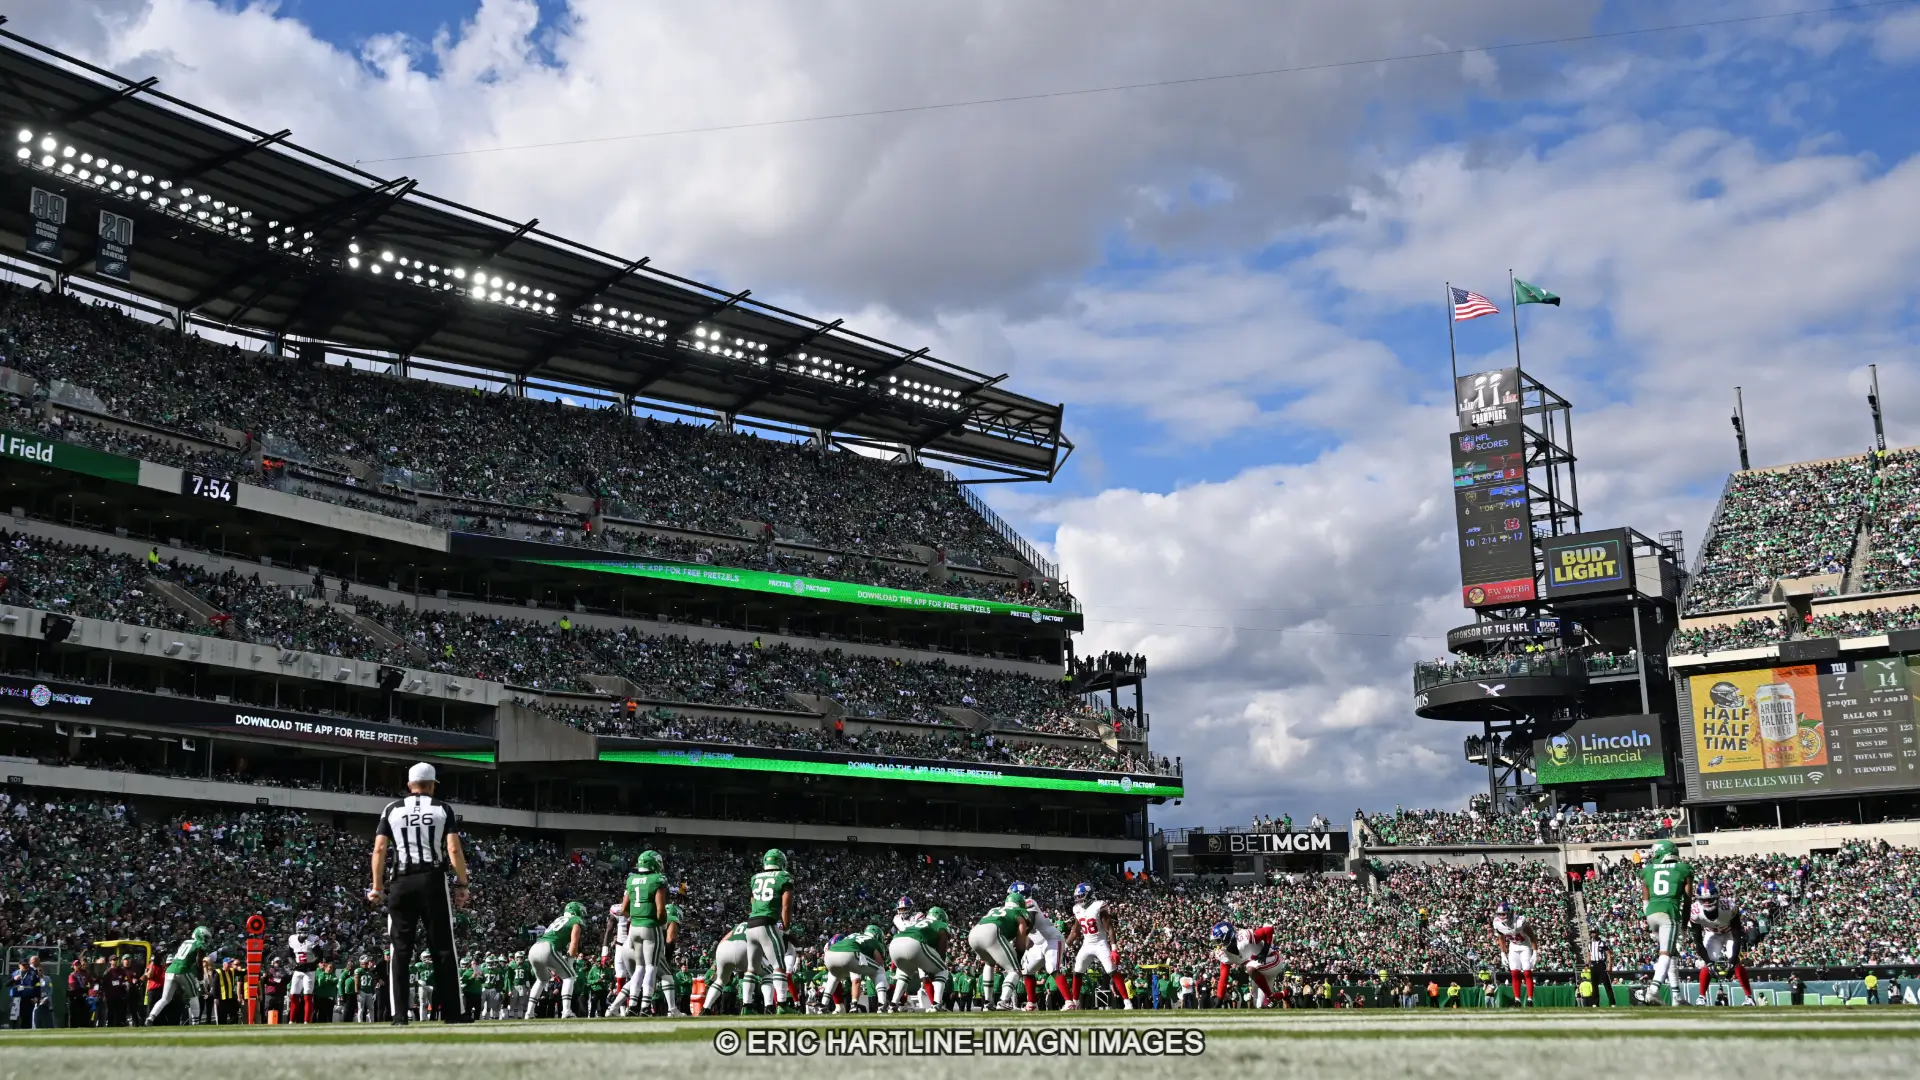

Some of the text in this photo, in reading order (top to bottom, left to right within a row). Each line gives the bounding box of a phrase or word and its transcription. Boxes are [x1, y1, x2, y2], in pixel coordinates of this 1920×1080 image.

[33, 189, 64, 224] 99
[35, 221, 59, 233] JEROME
[36, 228, 57, 240] BROWN
[101, 212, 132, 245] 20
[102, 249, 127, 261] DAWKINS
[107, 244, 123, 253] BRIAN
[1472, 409, 1507, 424] CHAMPIONS
[9, 437, 53, 462] Field
[1476, 440, 1508, 450] SCORES
[1510, 468, 1515, 476] 3
[192, 475, 231, 501] 7:54
[1511, 500, 1520, 508] 10
[1466, 539, 1475, 547] 10
[1482, 536, 1497, 544] 2:14
[1514, 532, 1523, 540] 17
[1561, 547, 1607, 566] BUD
[665, 566, 681, 575] FOR
[683, 568, 700, 577] FREE
[703, 571, 739, 583] PRETZELS
[1554, 560, 1616, 582] LIGHT
[768, 580, 831, 593] PRETZEL FACTORY
[1504, 584, 1530, 594] WEBB
[857, 590, 991, 614] DOWNLOAD THE APP FOR FREE PRETZELS
[1453, 627, 1481, 640] SPONSOR
[1482, 625, 1493, 635] OF
[1494, 623, 1511, 634] THE
[1512, 622, 1529, 632] NFL
[1537, 626, 1559, 634] LIGHT
[1836, 676, 1845, 690] 7
[1878, 672, 1897, 687] 14
[1761, 701, 1792, 714] ARNOLD
[1841, 699, 1857, 707] QTR
[1899, 694, 1908, 702] 10
[1704, 707, 1751, 721] HALF
[1761, 714, 1793, 726] PALMER
[1843, 711, 1865, 720] BALL
[235, 714, 418, 746] DOWNLOAD THE APP FOR FREE PRETZELS
[1704, 723, 1750, 737] HALF
[1830, 723, 1913, 737] 31 RUSH YDS 123
[1581, 730, 1651, 750] Lincoln
[1704, 736, 1748, 751] TIME
[1856, 740, 1872, 748] PASS
[1874, 739, 1888, 747] YDS
[1582, 749, 1642, 765] Financial
[1854, 753, 1878, 761] TOTAL
[1879, 751, 1893, 759] YDS
[847, 761, 1003, 779] DOWNLOAD THE APP FOR FREE PRETZELS
[1854, 764, 1897, 774] TURNOVERS
[1705, 773, 1804, 790] FREE EAGLES WIFI
[402, 814, 433, 826] 126
[1230, 834, 1331, 852] BETMGM
[752, 877, 775, 902] 26
[1653, 870, 1670, 896] 6
[634, 886, 641, 908] 1
[1079, 917, 1098, 934] 58
[361, 975, 373, 986] 87
